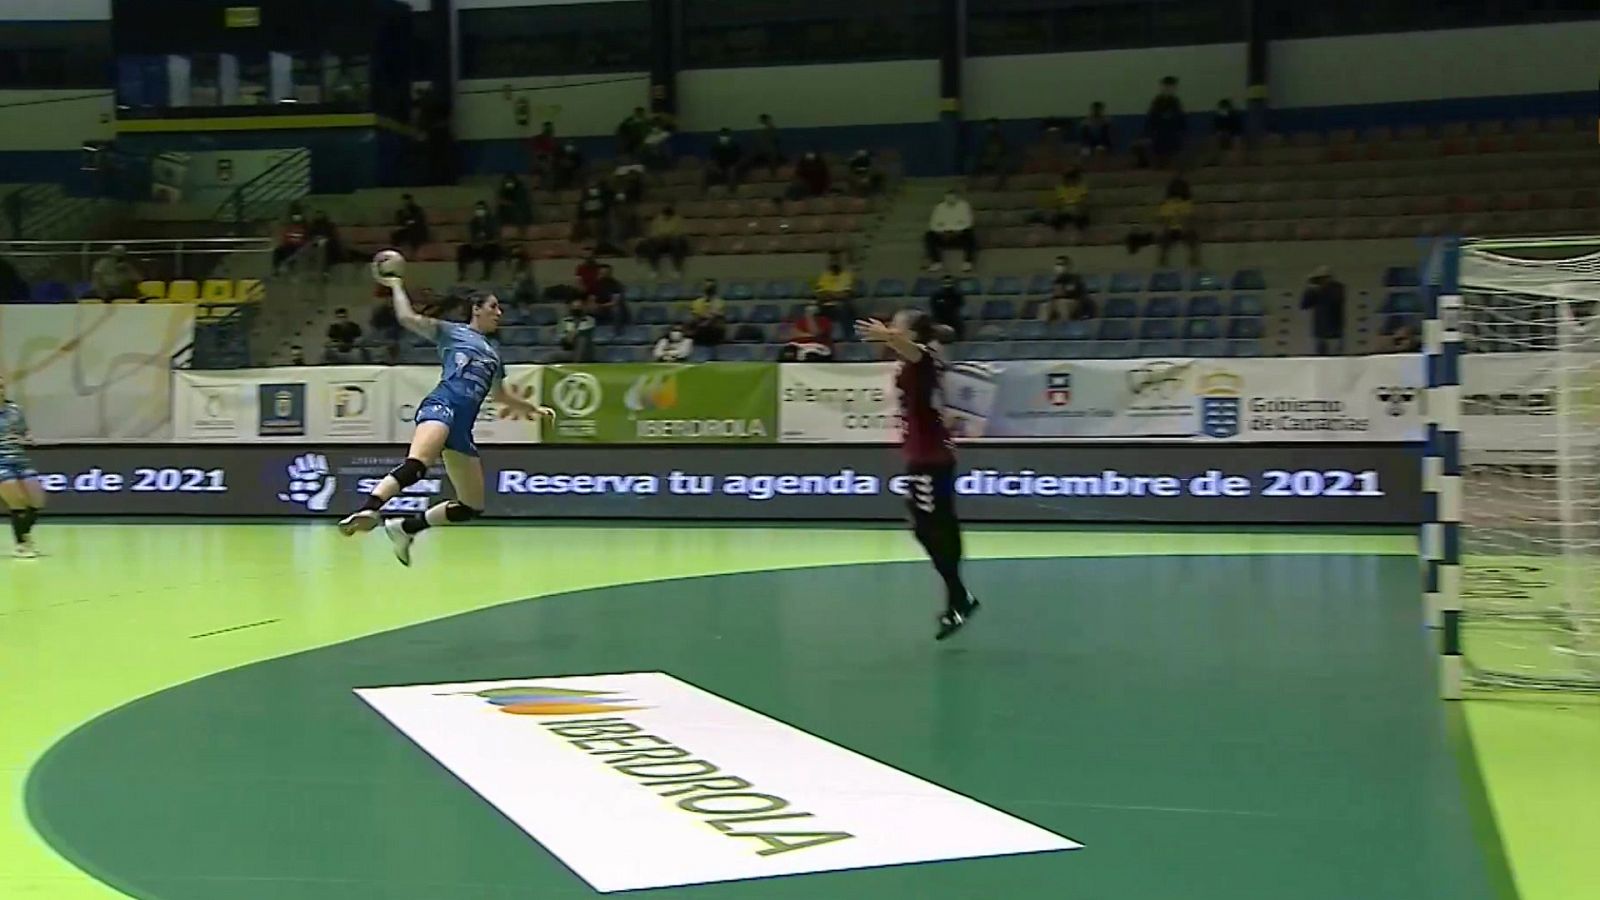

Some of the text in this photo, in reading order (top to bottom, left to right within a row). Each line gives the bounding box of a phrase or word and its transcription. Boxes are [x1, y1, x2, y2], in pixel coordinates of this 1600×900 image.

[74, 469, 124, 492] de
[131, 468, 228, 492] 2021
[497, 470, 658, 494] Reserva
[667, 472, 714, 494] tu
[722, 469, 880, 500] agenda
[954, 469, 1182, 496] diciembre
[1188, 470, 1250, 496] de
[1260, 470, 1386, 497] 2021
[538, 716, 856, 857] IBERDROLA
